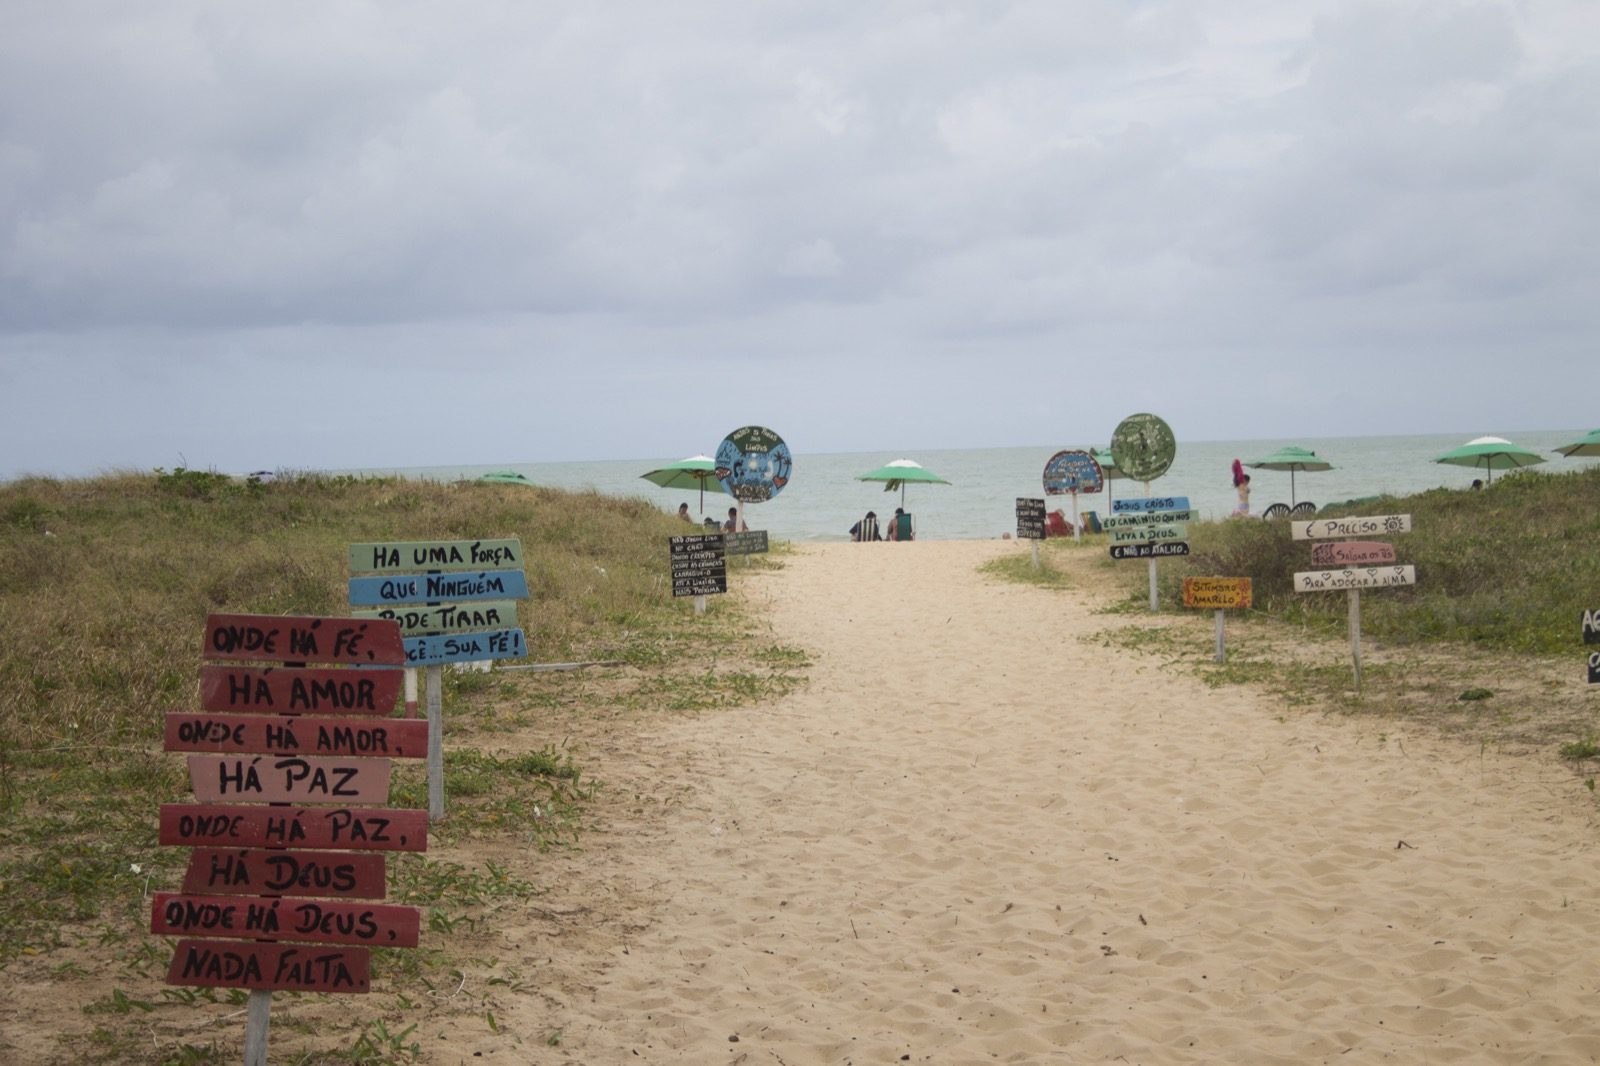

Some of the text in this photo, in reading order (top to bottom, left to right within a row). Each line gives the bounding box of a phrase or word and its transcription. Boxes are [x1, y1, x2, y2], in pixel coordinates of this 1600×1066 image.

[1113, 498, 1174, 511] JESUS CRISTO
[1118, 514, 1161, 527] CAMINHO
[1175, 512, 1190, 521] NOS
[1325, 520, 1378, 536] PRECISO
[1115, 532, 1137, 540] LEVA
[373, 541, 516, 569] HA UMA FORÇA
[1114, 548, 1121, 557] E
[1152, 544, 1188, 555] ATALHO.
[380, 572, 505, 600] QUE NINGUÉM
[1192, 581, 1237, 592] SETEMBRO
[1302, 575, 1407, 589] PARA ADOÇAR A ALMA
[1193, 595, 1235, 605] AMARELO
[435, 605, 501, 628] TIRAR
[212, 619, 375, 660] ONDE HÁ FÉ,
[444, 639, 482, 656] SUA
[229, 667, 376, 711] HÁ AMOR
[178, 719, 403, 756] ONDE HÁ AMOR,
[219, 757, 360, 797] HÁ PAZ
[178, 809, 407, 847] ONDE HÁ PAZ,
[208, 850, 356, 892] HÁ DEUS
[165, 900, 398, 941] ONDE HÁ DEUS,
[182, 947, 366, 988] NADA FALTA.
